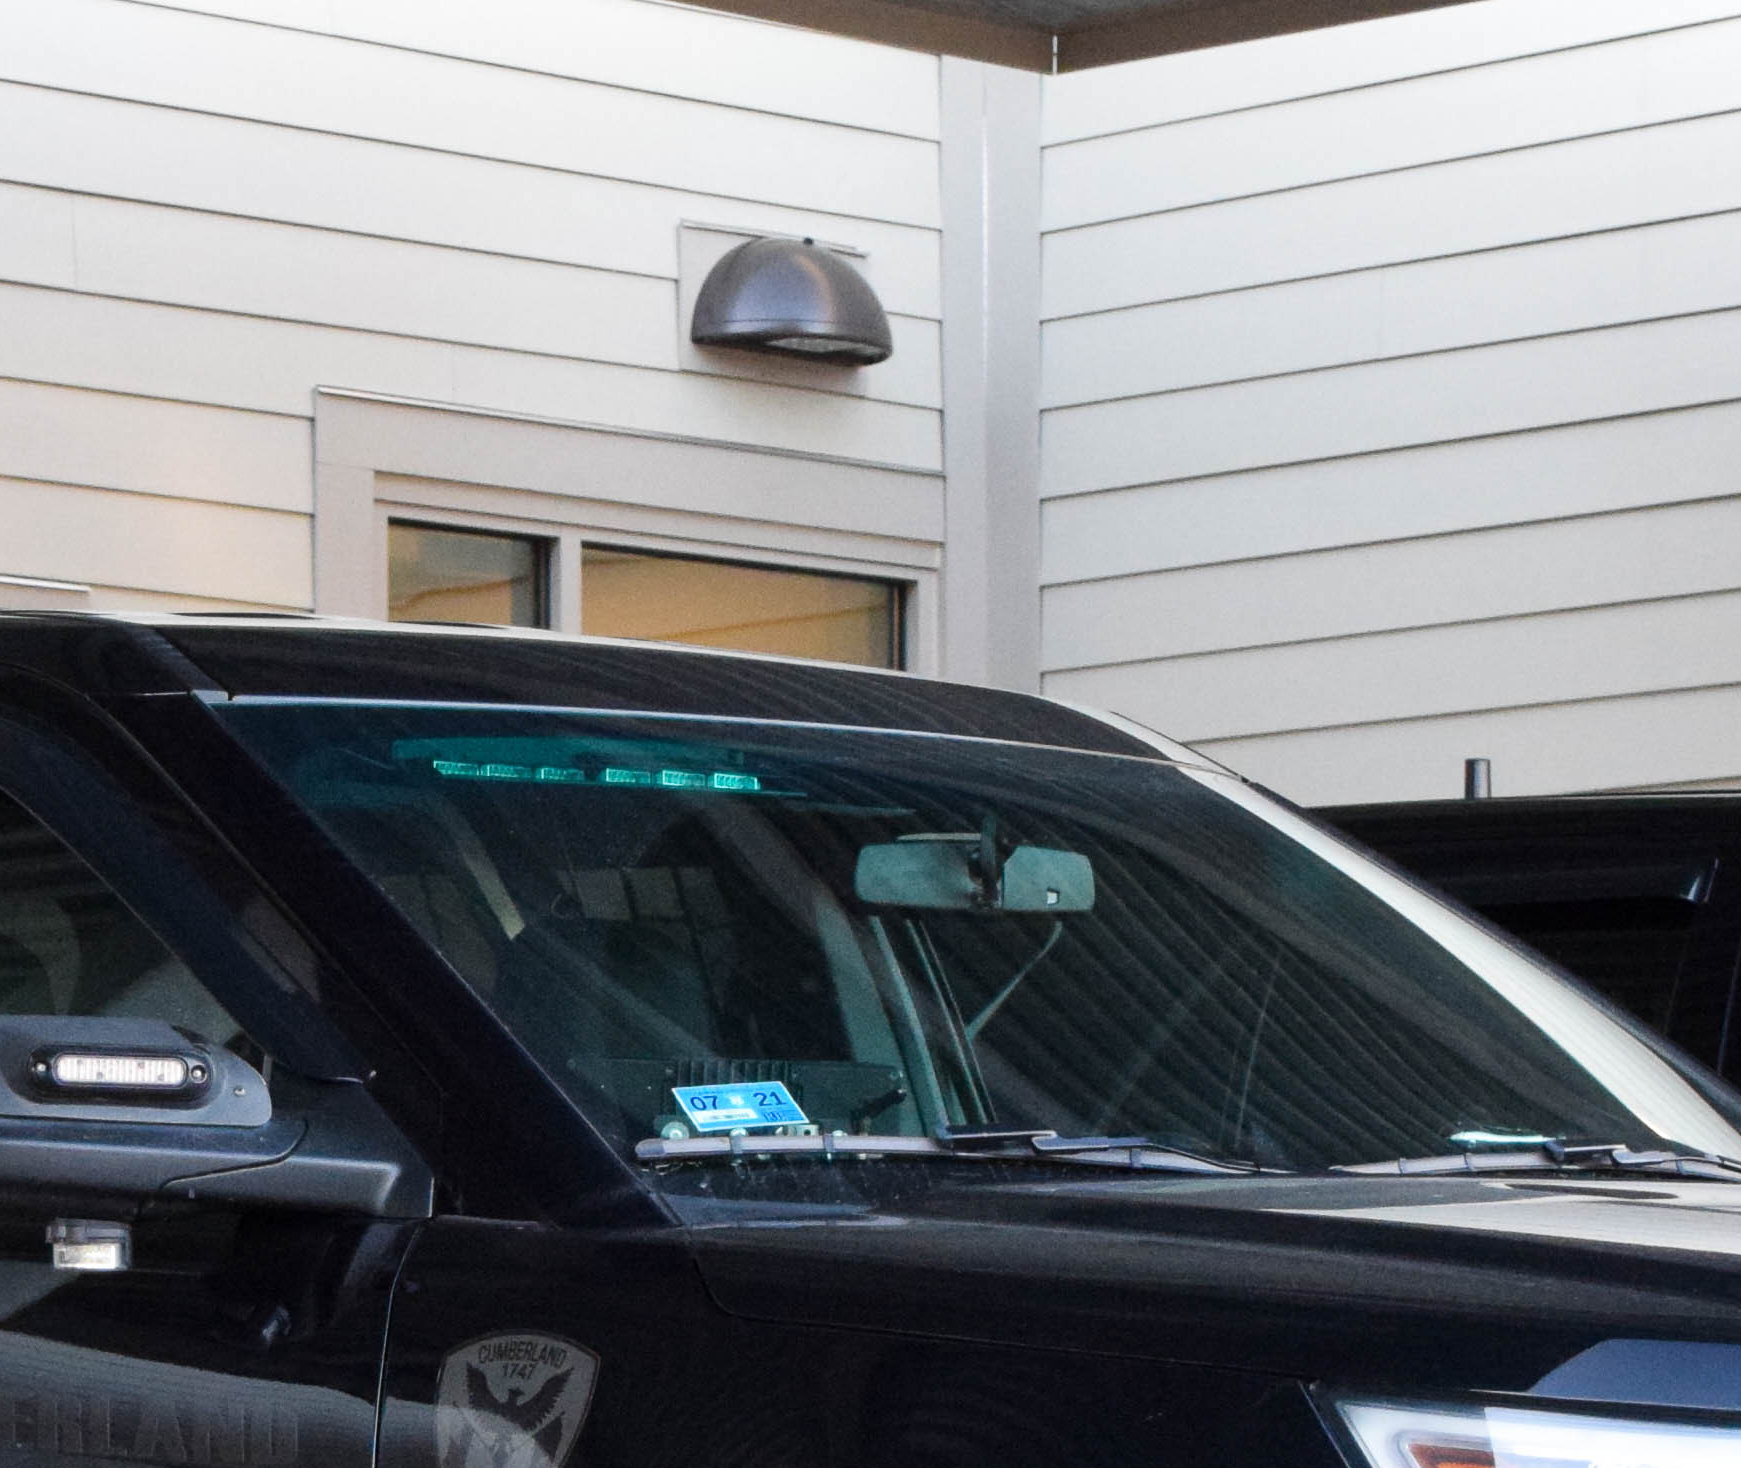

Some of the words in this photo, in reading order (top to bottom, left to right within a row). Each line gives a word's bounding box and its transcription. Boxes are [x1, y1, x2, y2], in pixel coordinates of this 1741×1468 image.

[690, 1095, 718, 1111] 07
[753, 1091, 786, 1107] 21
[478, 1340, 567, 1369] CUMBERLAND
[502, 1363, 536, 1381] 1747
